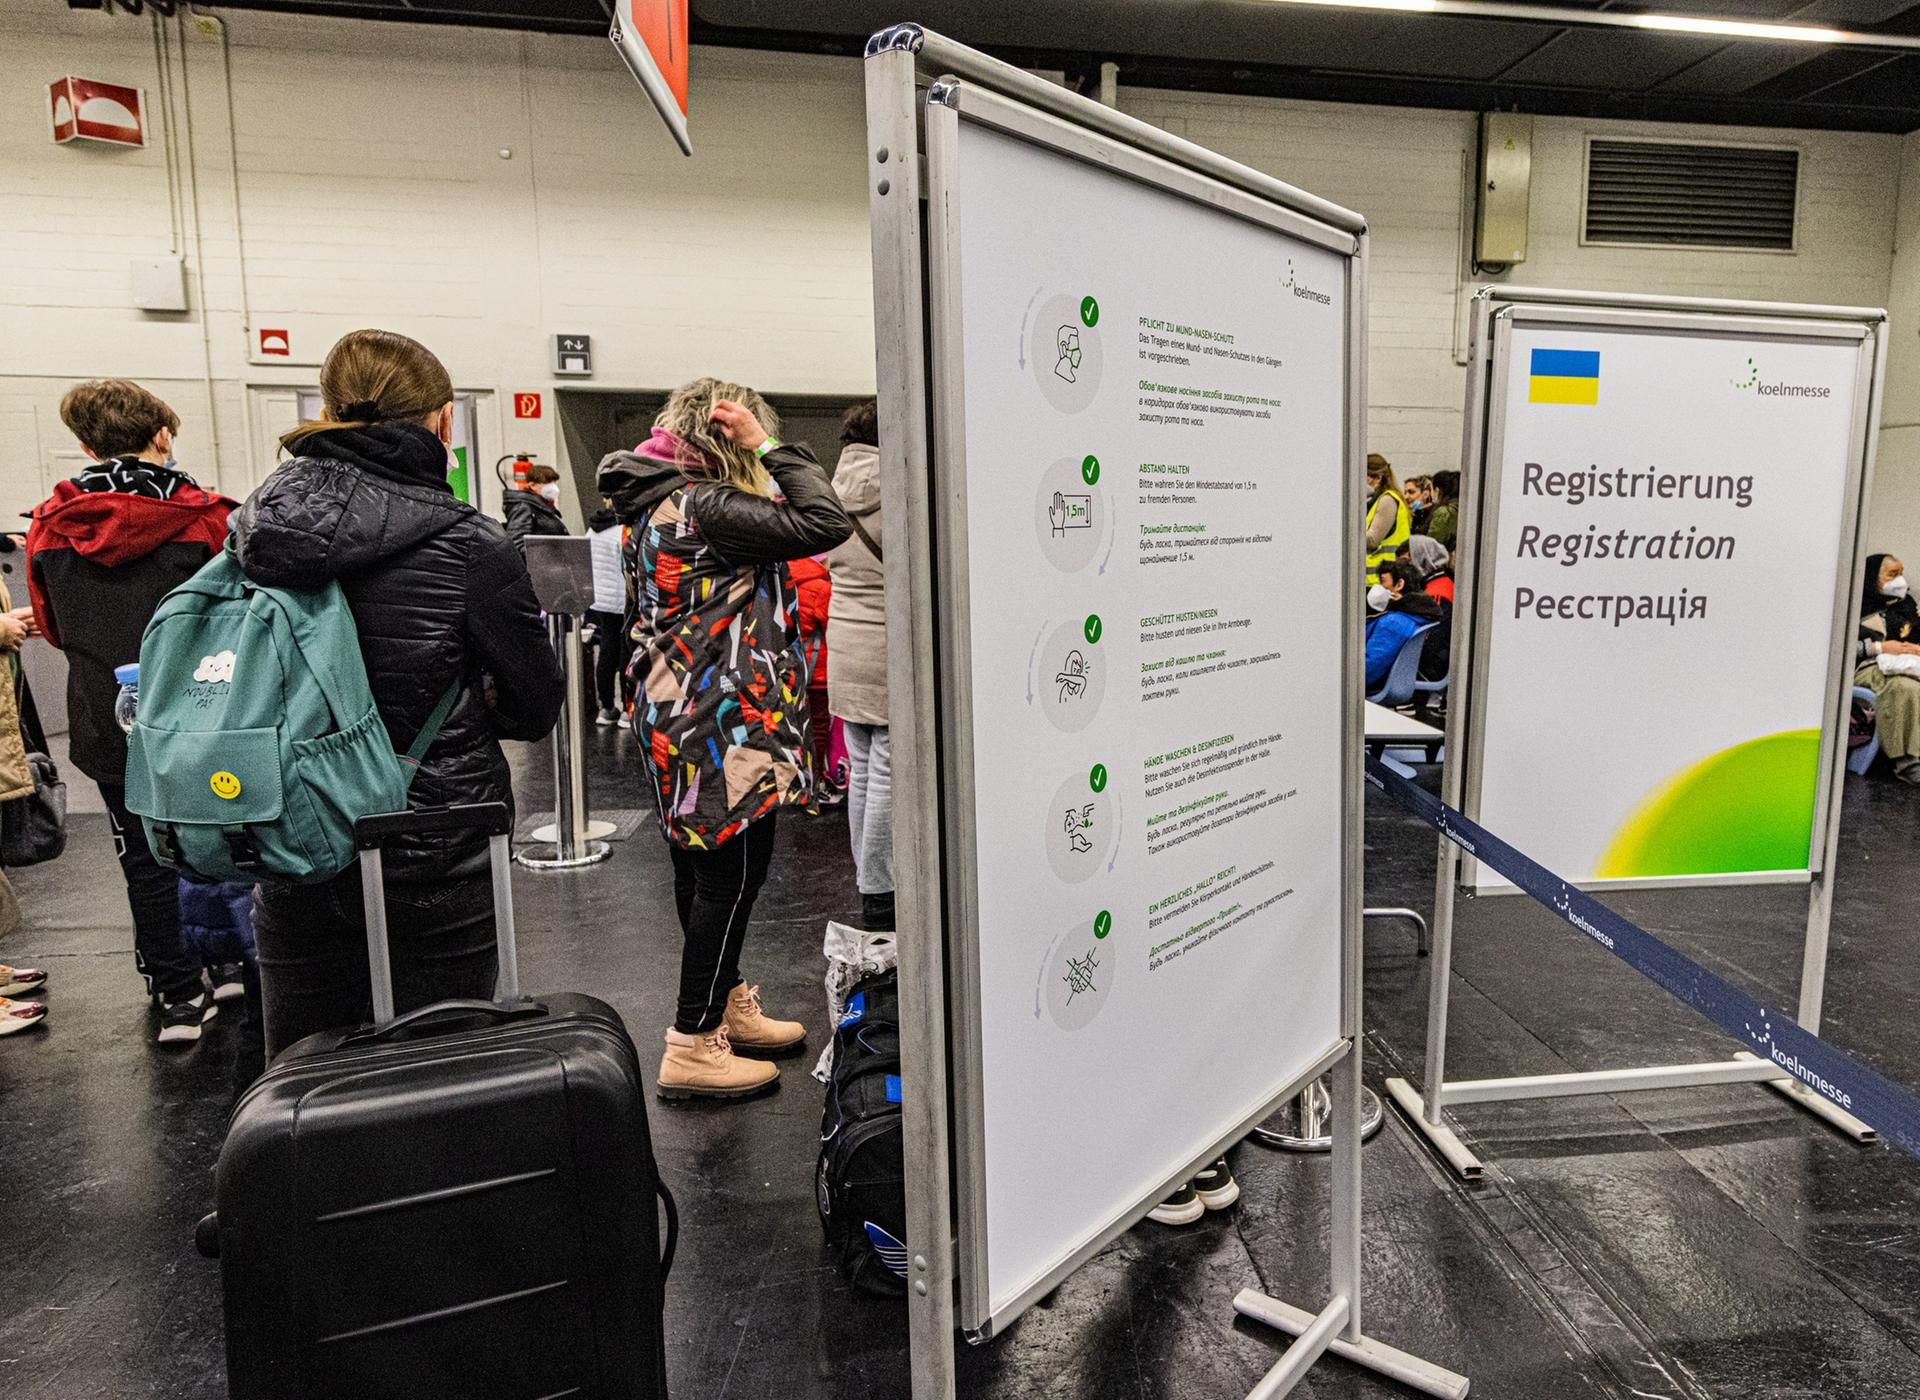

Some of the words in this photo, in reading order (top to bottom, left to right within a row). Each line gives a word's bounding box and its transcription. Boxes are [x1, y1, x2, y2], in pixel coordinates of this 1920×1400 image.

[1294, 282, 1331, 306] koelnmesse
[1139, 317, 1164, 331] PFLICHT
[1166, 322, 1174, 332] ZU
[1139, 333, 1149, 343] Das
[1151, 335, 1169, 348] Tragen
[1171, 339, 1184, 349] eines
[1186, 342, 1202, 352] Mund-
[1203, 346, 1213, 355] und
[1214, 346, 1250, 362] Nasen-Schutzes
[1251, 354, 1255, 363] in
[1256, 355, 1264, 364] den
[1148, 351, 1191, 366] vorgeschrieben.
[1757, 381, 1831, 398] koelnmesse
[1139, 464, 1166, 473] ABSTAND
[1168, 465, 1189, 474] HALTEN
[1139, 479, 1153, 489] Bitte
[1155, 479, 1174, 489] wahren
[1185, 480, 1195, 489] den
[1196, 481, 1233, 490] Mindestabstand
[1522, 463, 1753, 508] Registrierung
[1148, 495, 1170, 503] fremden
[1172, 495, 1197, 503] Personen.
[1517, 525, 1735, 566] Registration
[1514, 587, 1707, 627] Реєстрація
[1140, 613, 1174, 627] GESCHÜTZT
[1140, 632, 1154, 643] Bitte
[1156, 630, 1174, 640] husten
[1175, 628, 1185, 637] und
[1186, 626, 1202, 635] niesen
[1203, 623, 1211, 633] Sie
[1212, 622, 1216, 631] in
[1218, 621, 1227, 631] Ihre
[1144, 754, 1164, 769] HÄNDE
[1166, 748, 1192, 762] WASCHEN
[1193, 746, 1196, 754] &
[1568, 908, 1614, 950] koelnmesse
[1771, 1041, 1851, 1109] koelnmesse
